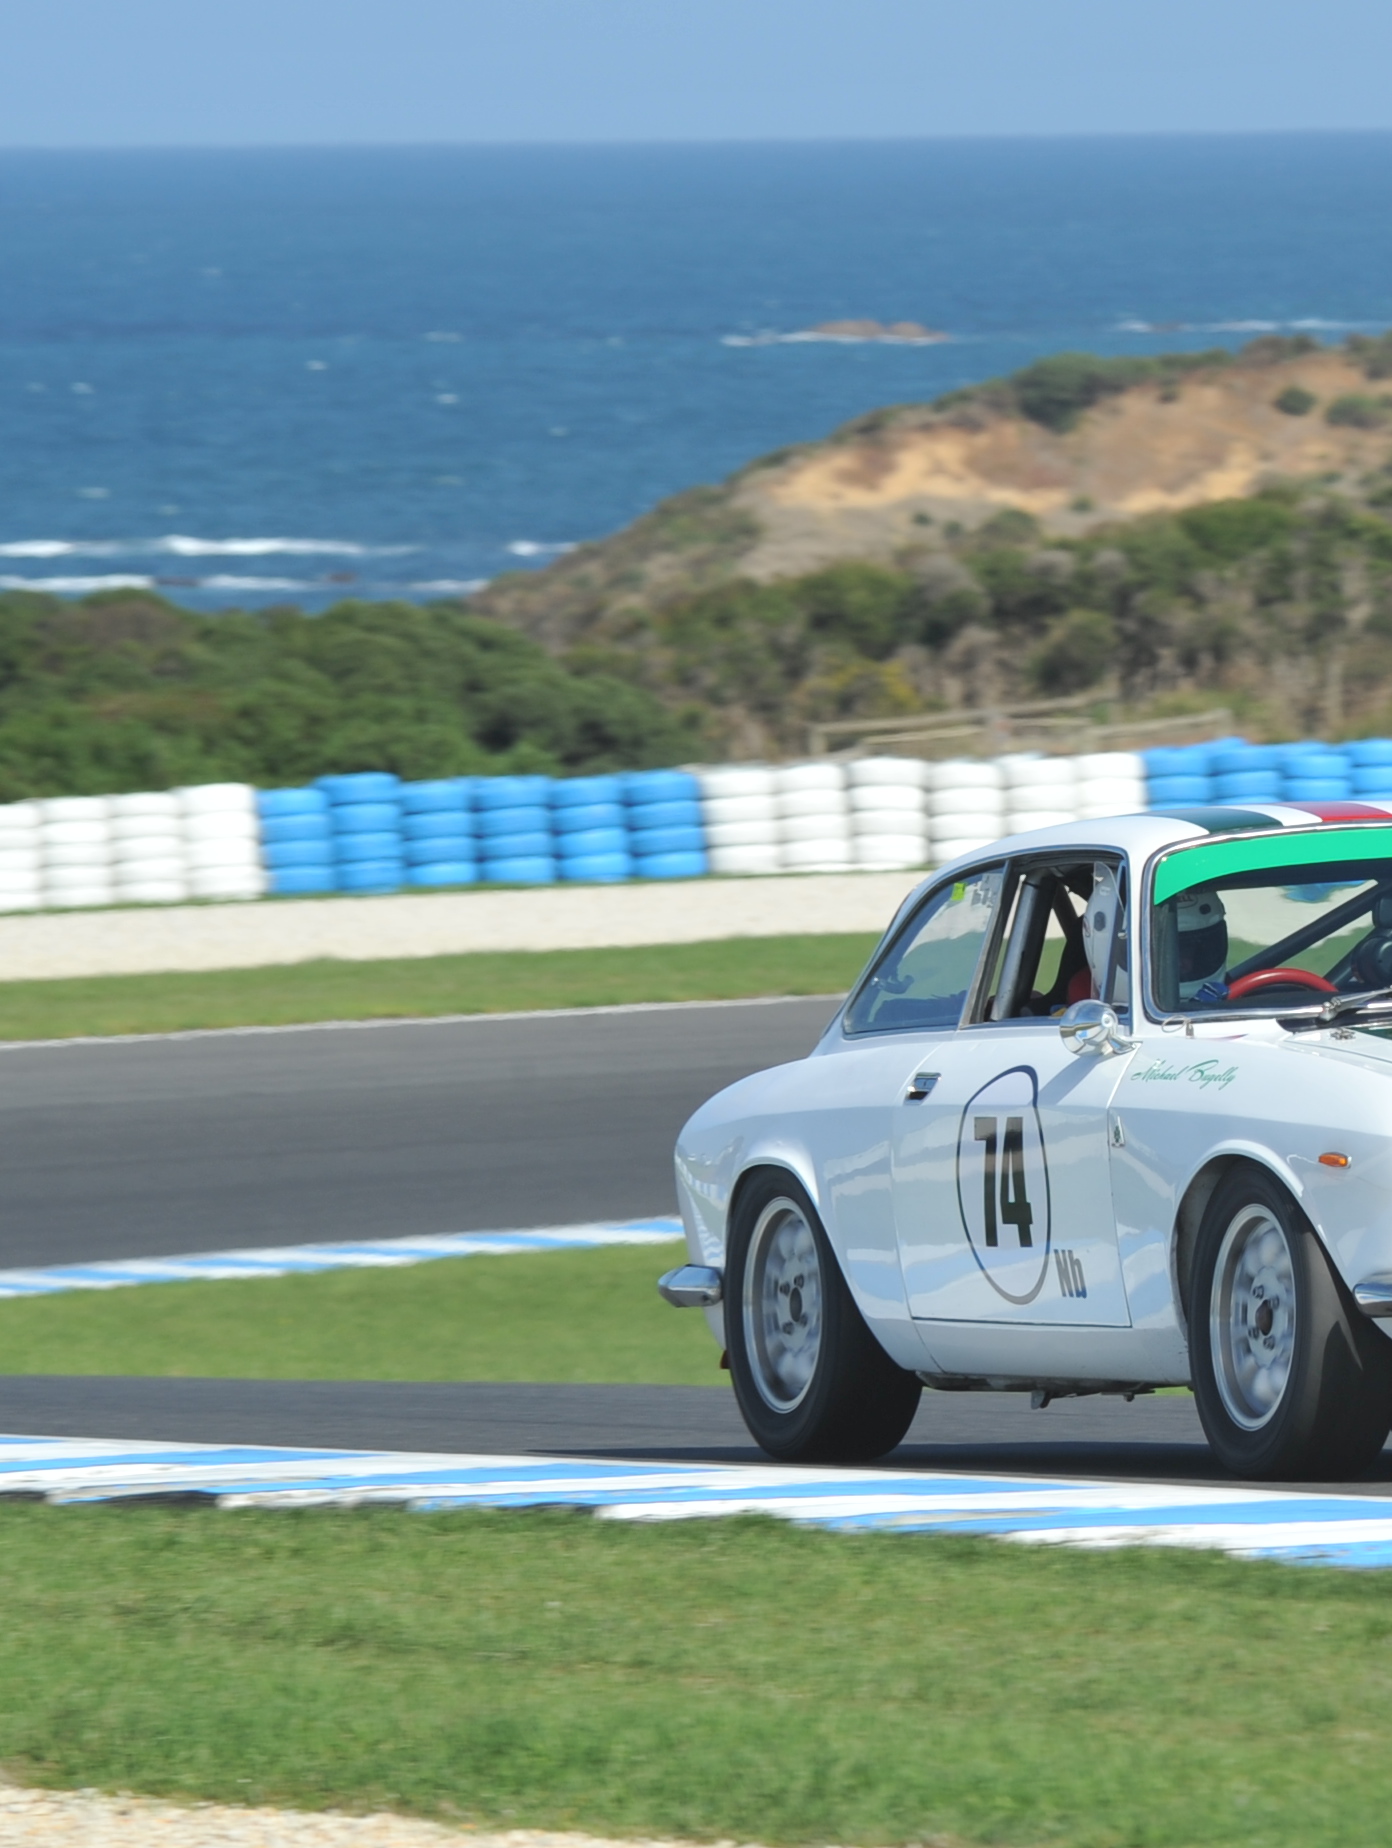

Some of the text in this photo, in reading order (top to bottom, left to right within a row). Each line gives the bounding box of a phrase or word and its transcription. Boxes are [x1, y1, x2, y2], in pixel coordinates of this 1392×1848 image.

[1131, 1059, 1189, 1082] Michael
[974, 1116, 1033, 1247] 74
[1053, 1249, 1087, 1298] Nb
